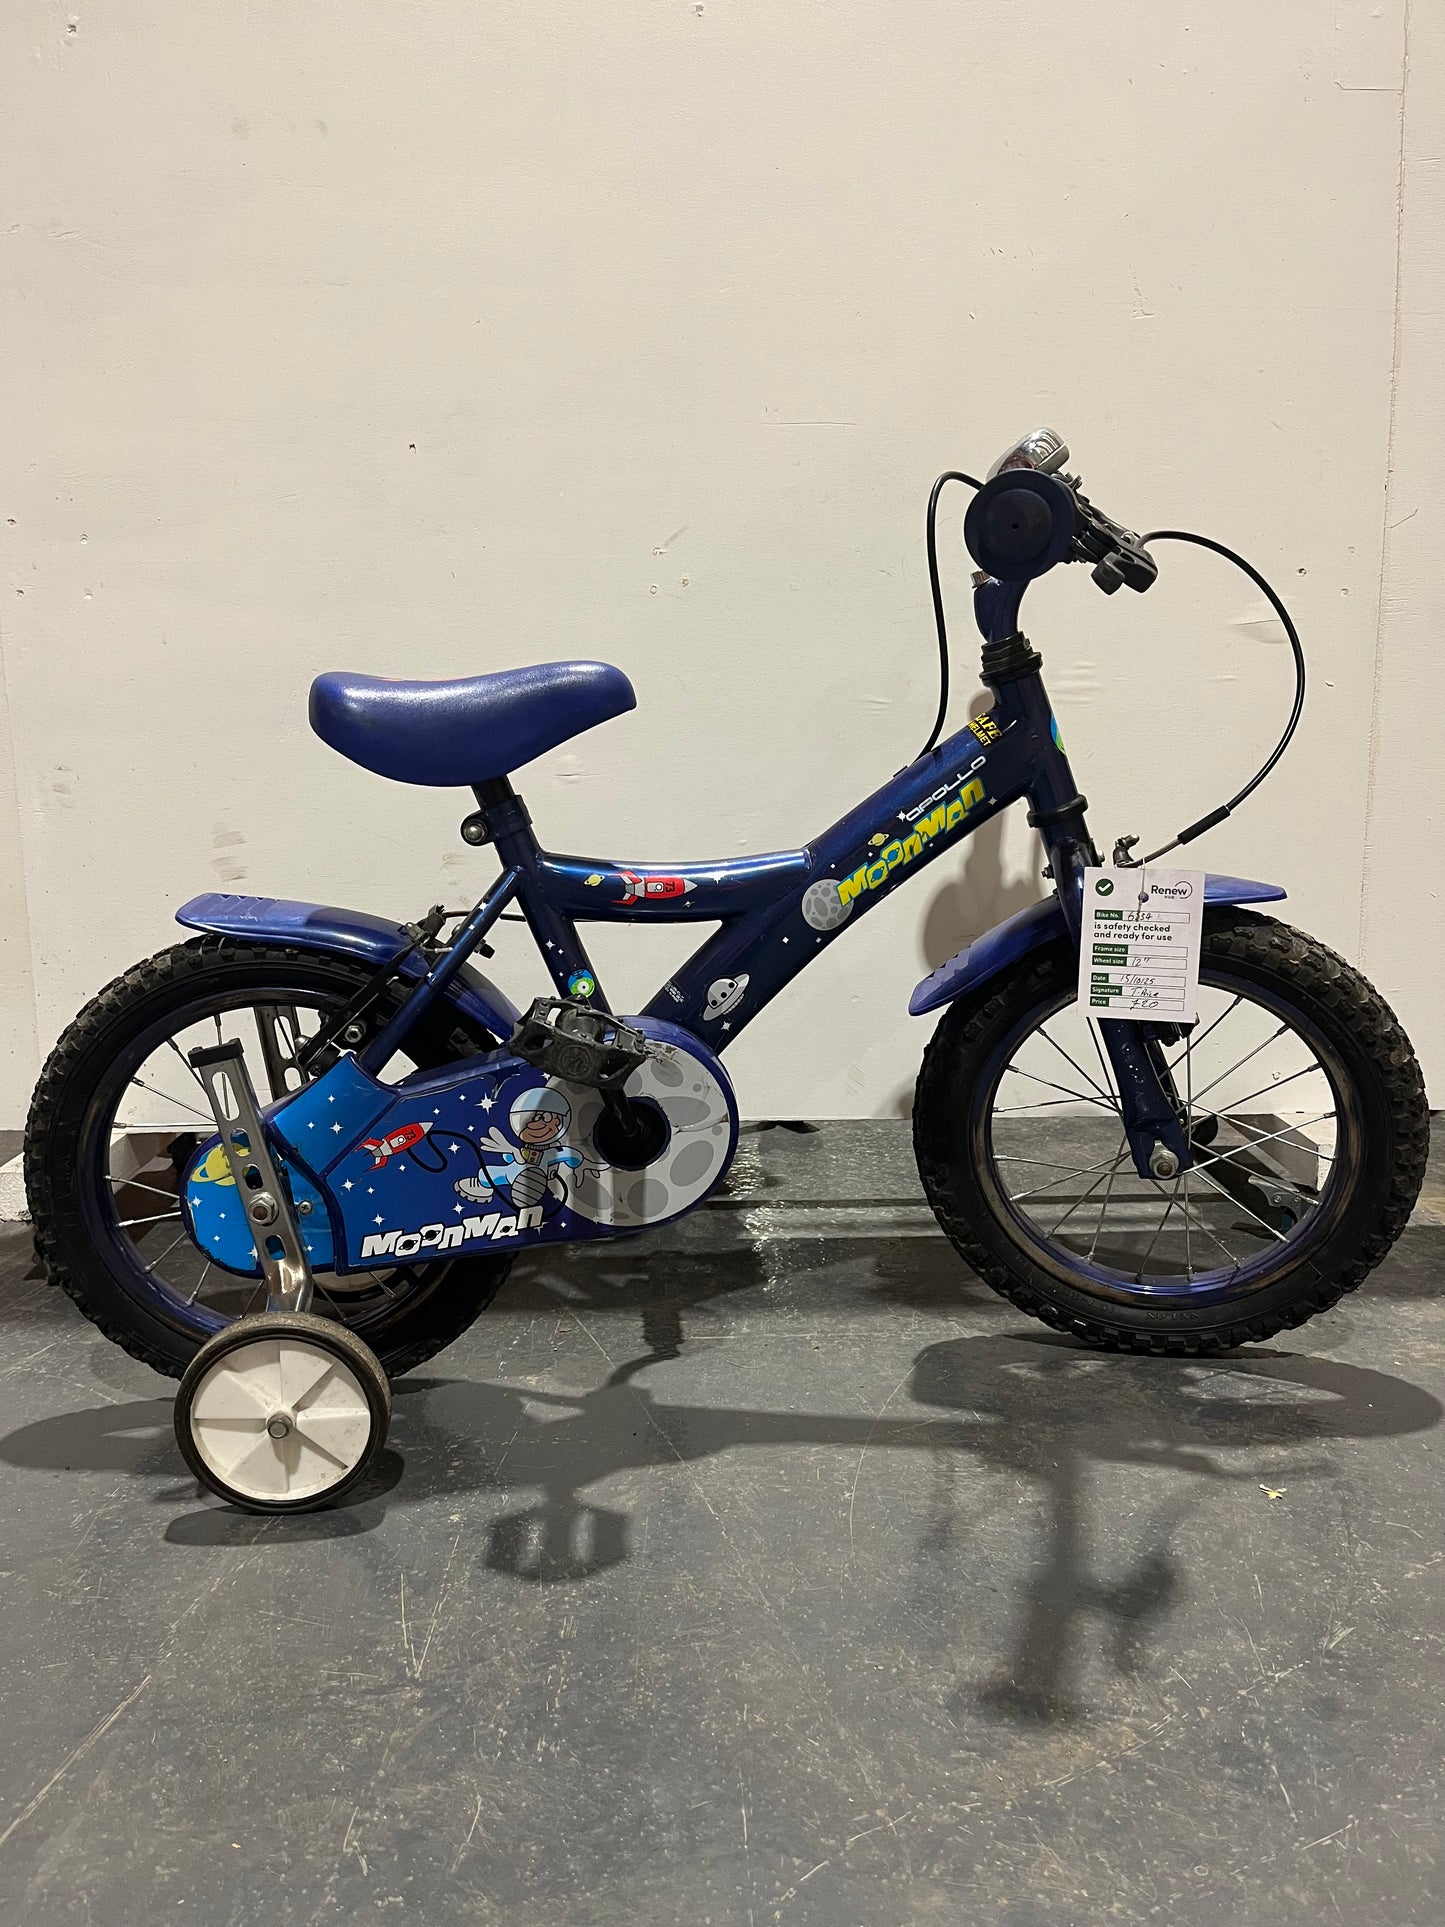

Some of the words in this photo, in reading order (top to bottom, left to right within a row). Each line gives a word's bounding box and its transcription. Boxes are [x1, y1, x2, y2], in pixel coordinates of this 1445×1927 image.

[1151, 885, 1188, 896] Renew
[1094, 922, 1102, 930] is
[1104, 922, 1132, 933] safety
[1133, 923, 1171, 933] checked
[1094, 931, 1112, 939] and
[1113, 932, 1140, 942] ready
[1141, 933, 1155, 941] for
[1092, 986, 1120, 994] Signature
